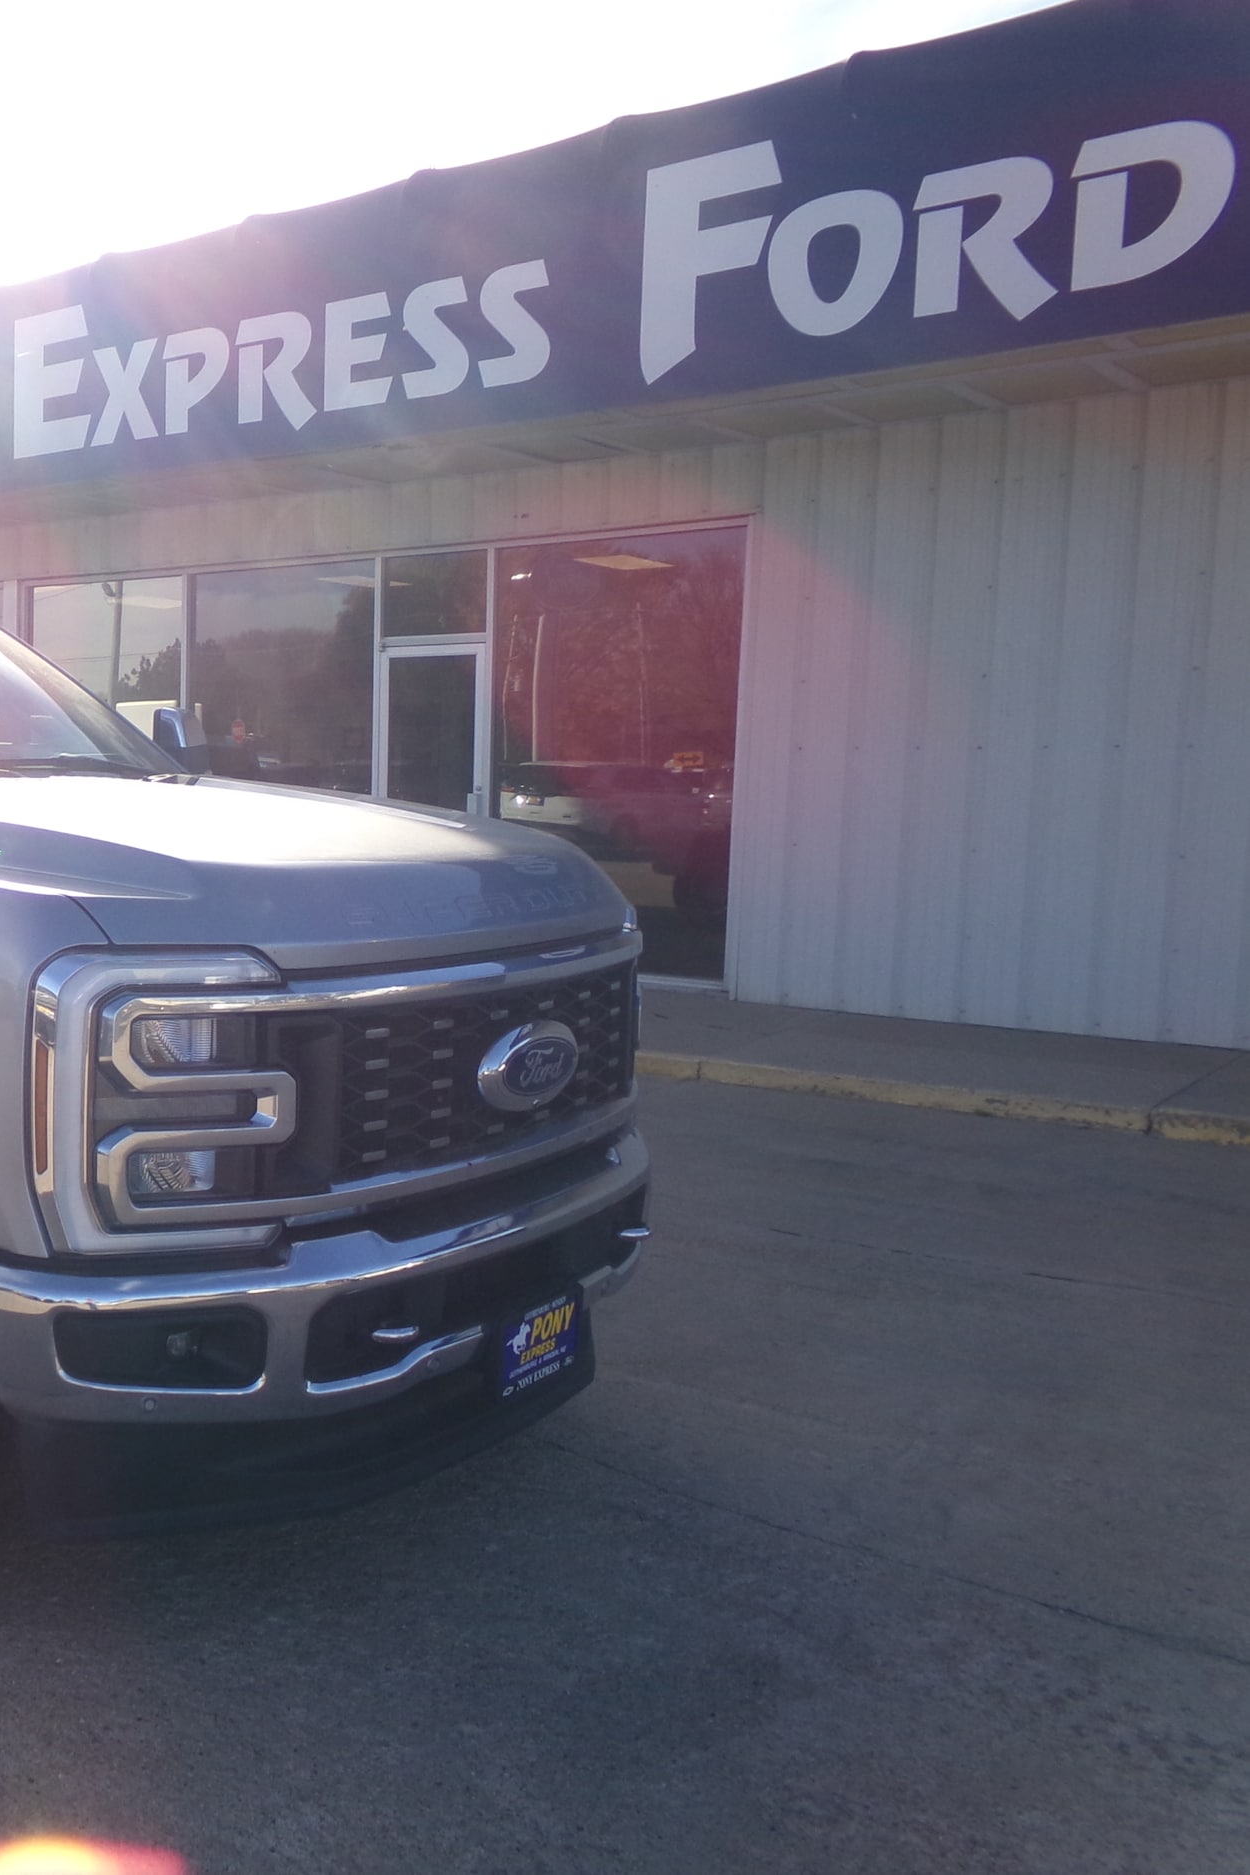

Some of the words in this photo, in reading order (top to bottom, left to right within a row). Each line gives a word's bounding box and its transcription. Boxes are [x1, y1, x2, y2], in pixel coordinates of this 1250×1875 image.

[13, 259, 550, 459] EXPRESS
[639, 120, 1236, 385] FORD
[523, 881, 600, 912] DUT
[520, 1047, 565, 1088] Ford
[530, 1302, 575, 1345] PONY
[520, 1338, 557, 1365] EXPRESS
